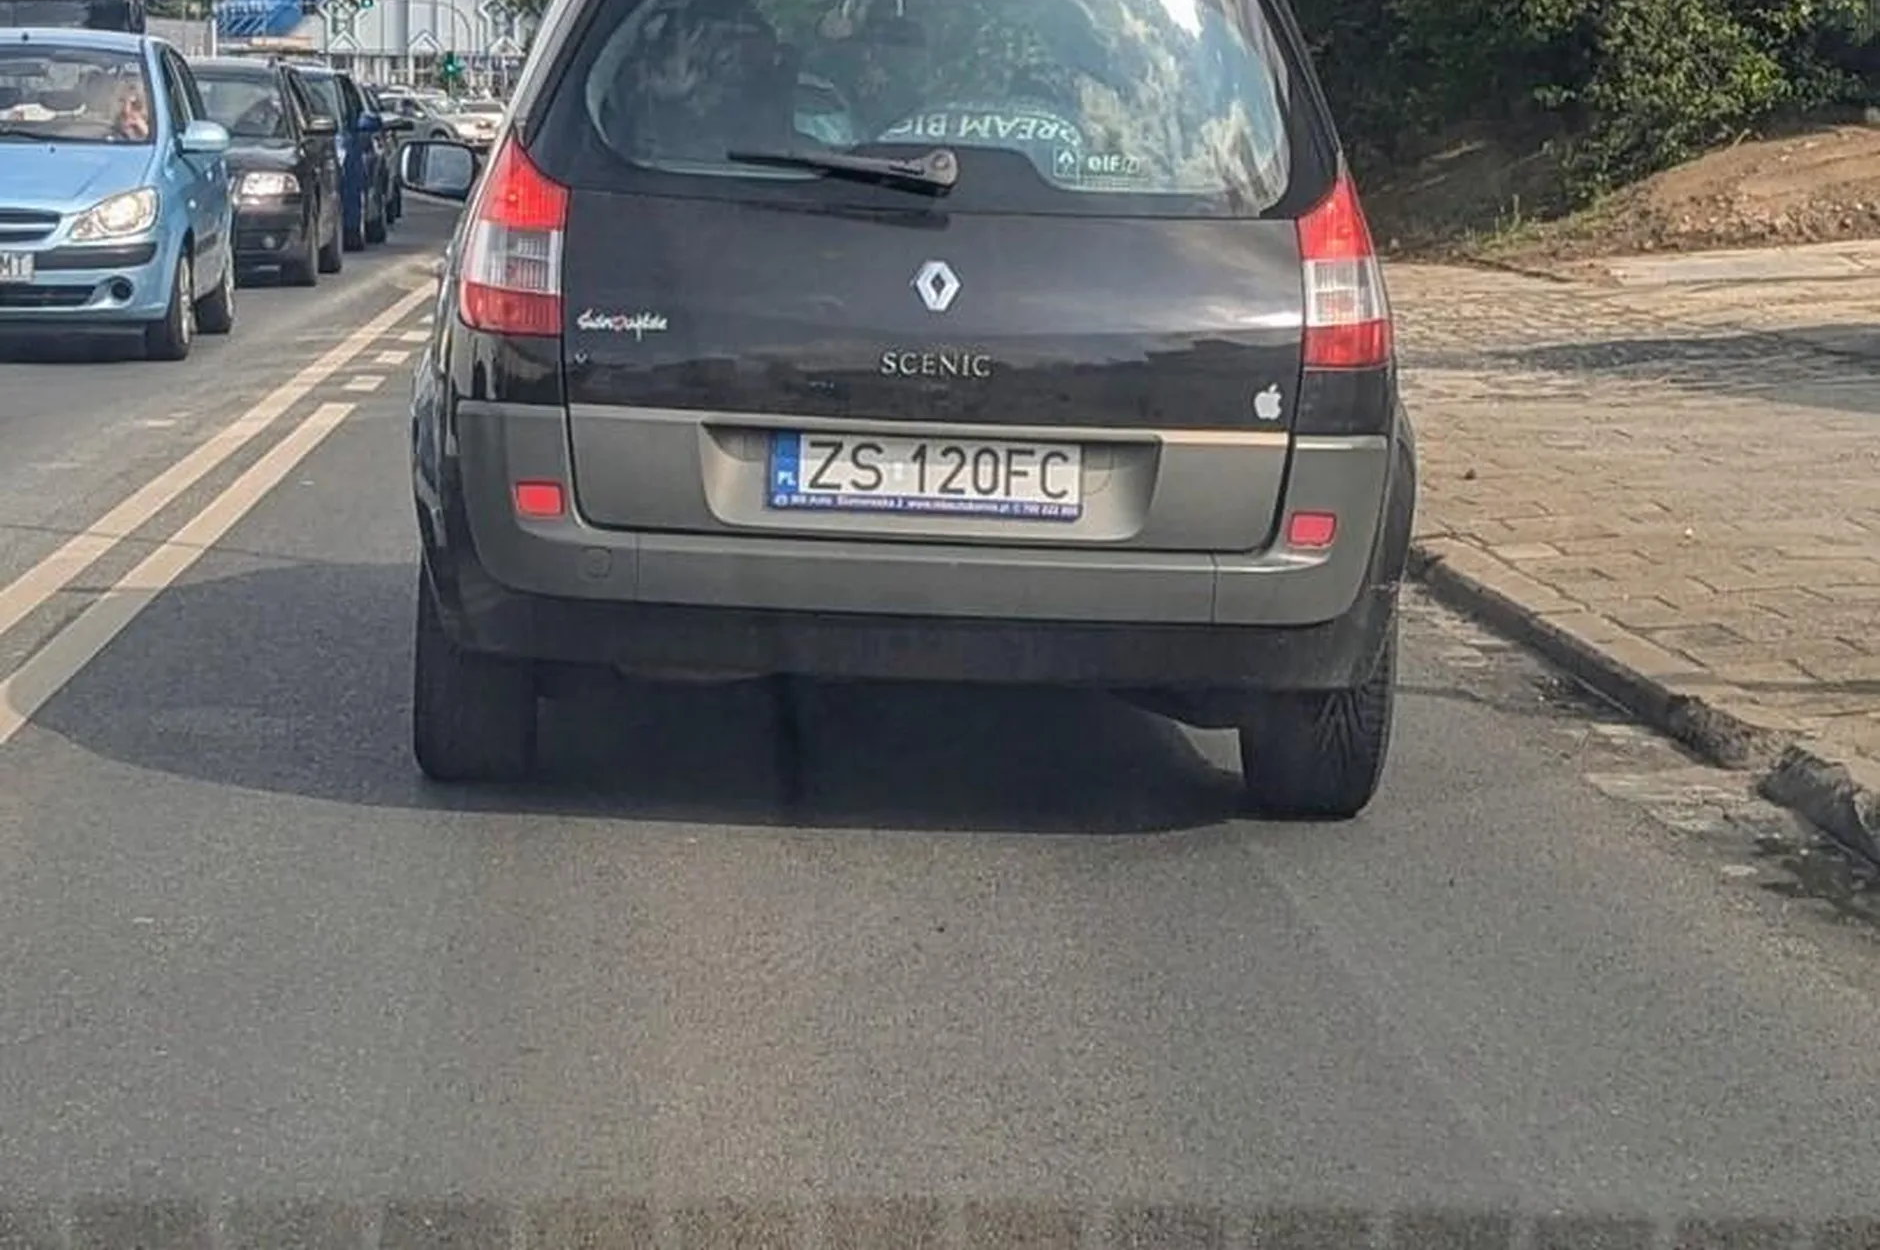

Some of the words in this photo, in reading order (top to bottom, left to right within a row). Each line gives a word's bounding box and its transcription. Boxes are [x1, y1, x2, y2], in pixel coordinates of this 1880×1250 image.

[957, 114, 1082, 147] DREAM
[880, 350, 992, 378] SCENIC
[777, 471, 797, 486] PL
[808, 440, 884, 491] ZS
[911, 443, 1069, 500] 120FC
